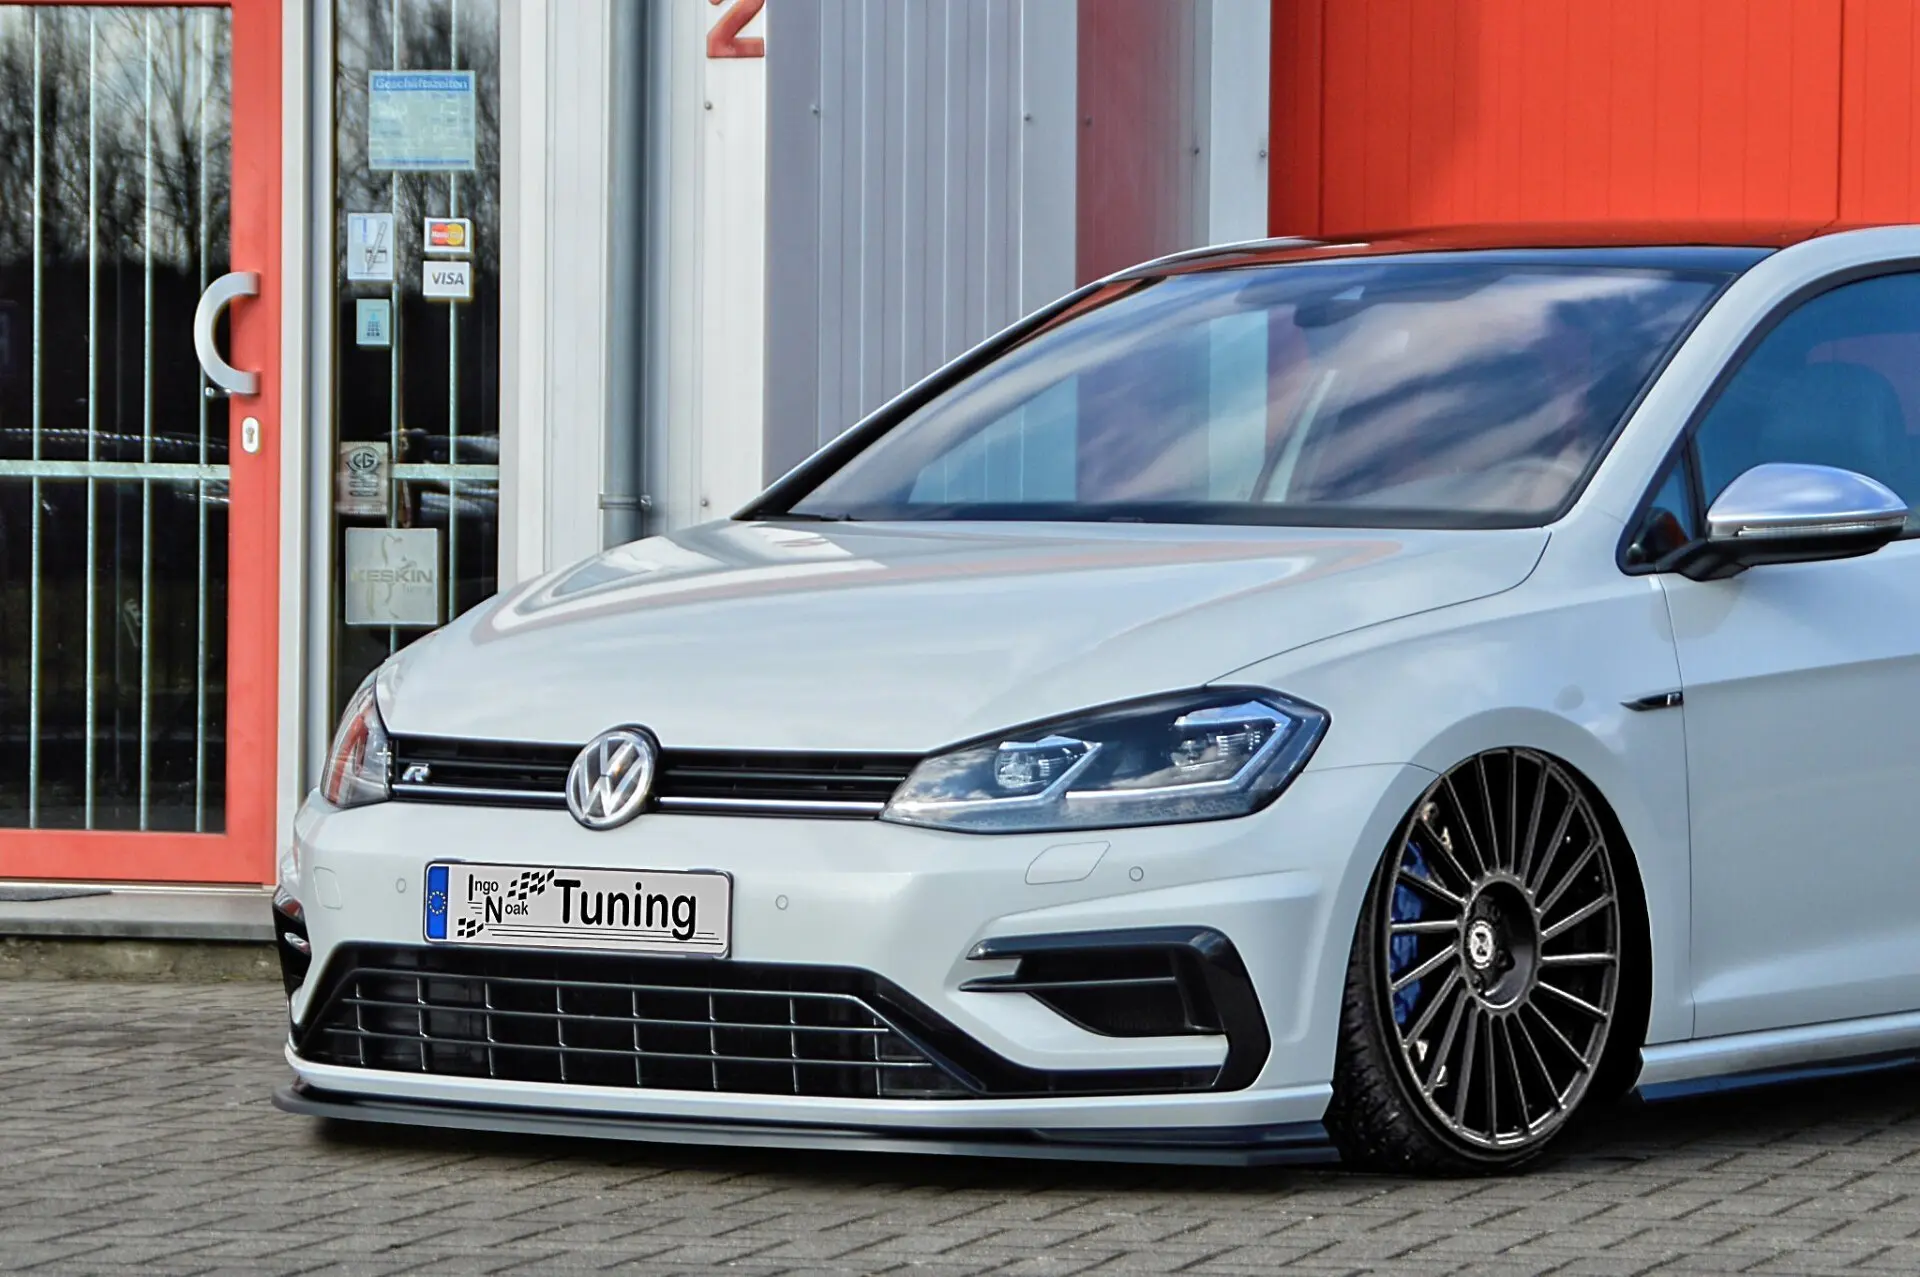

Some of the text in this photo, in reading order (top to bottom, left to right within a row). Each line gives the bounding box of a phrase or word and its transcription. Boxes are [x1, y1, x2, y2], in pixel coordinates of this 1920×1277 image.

[706, 0, 765, 58] 2
[431, 272, 465, 285] VISA
[402, 762, 431, 782] R
[468, 873, 697, 941] Ingo Tuning
